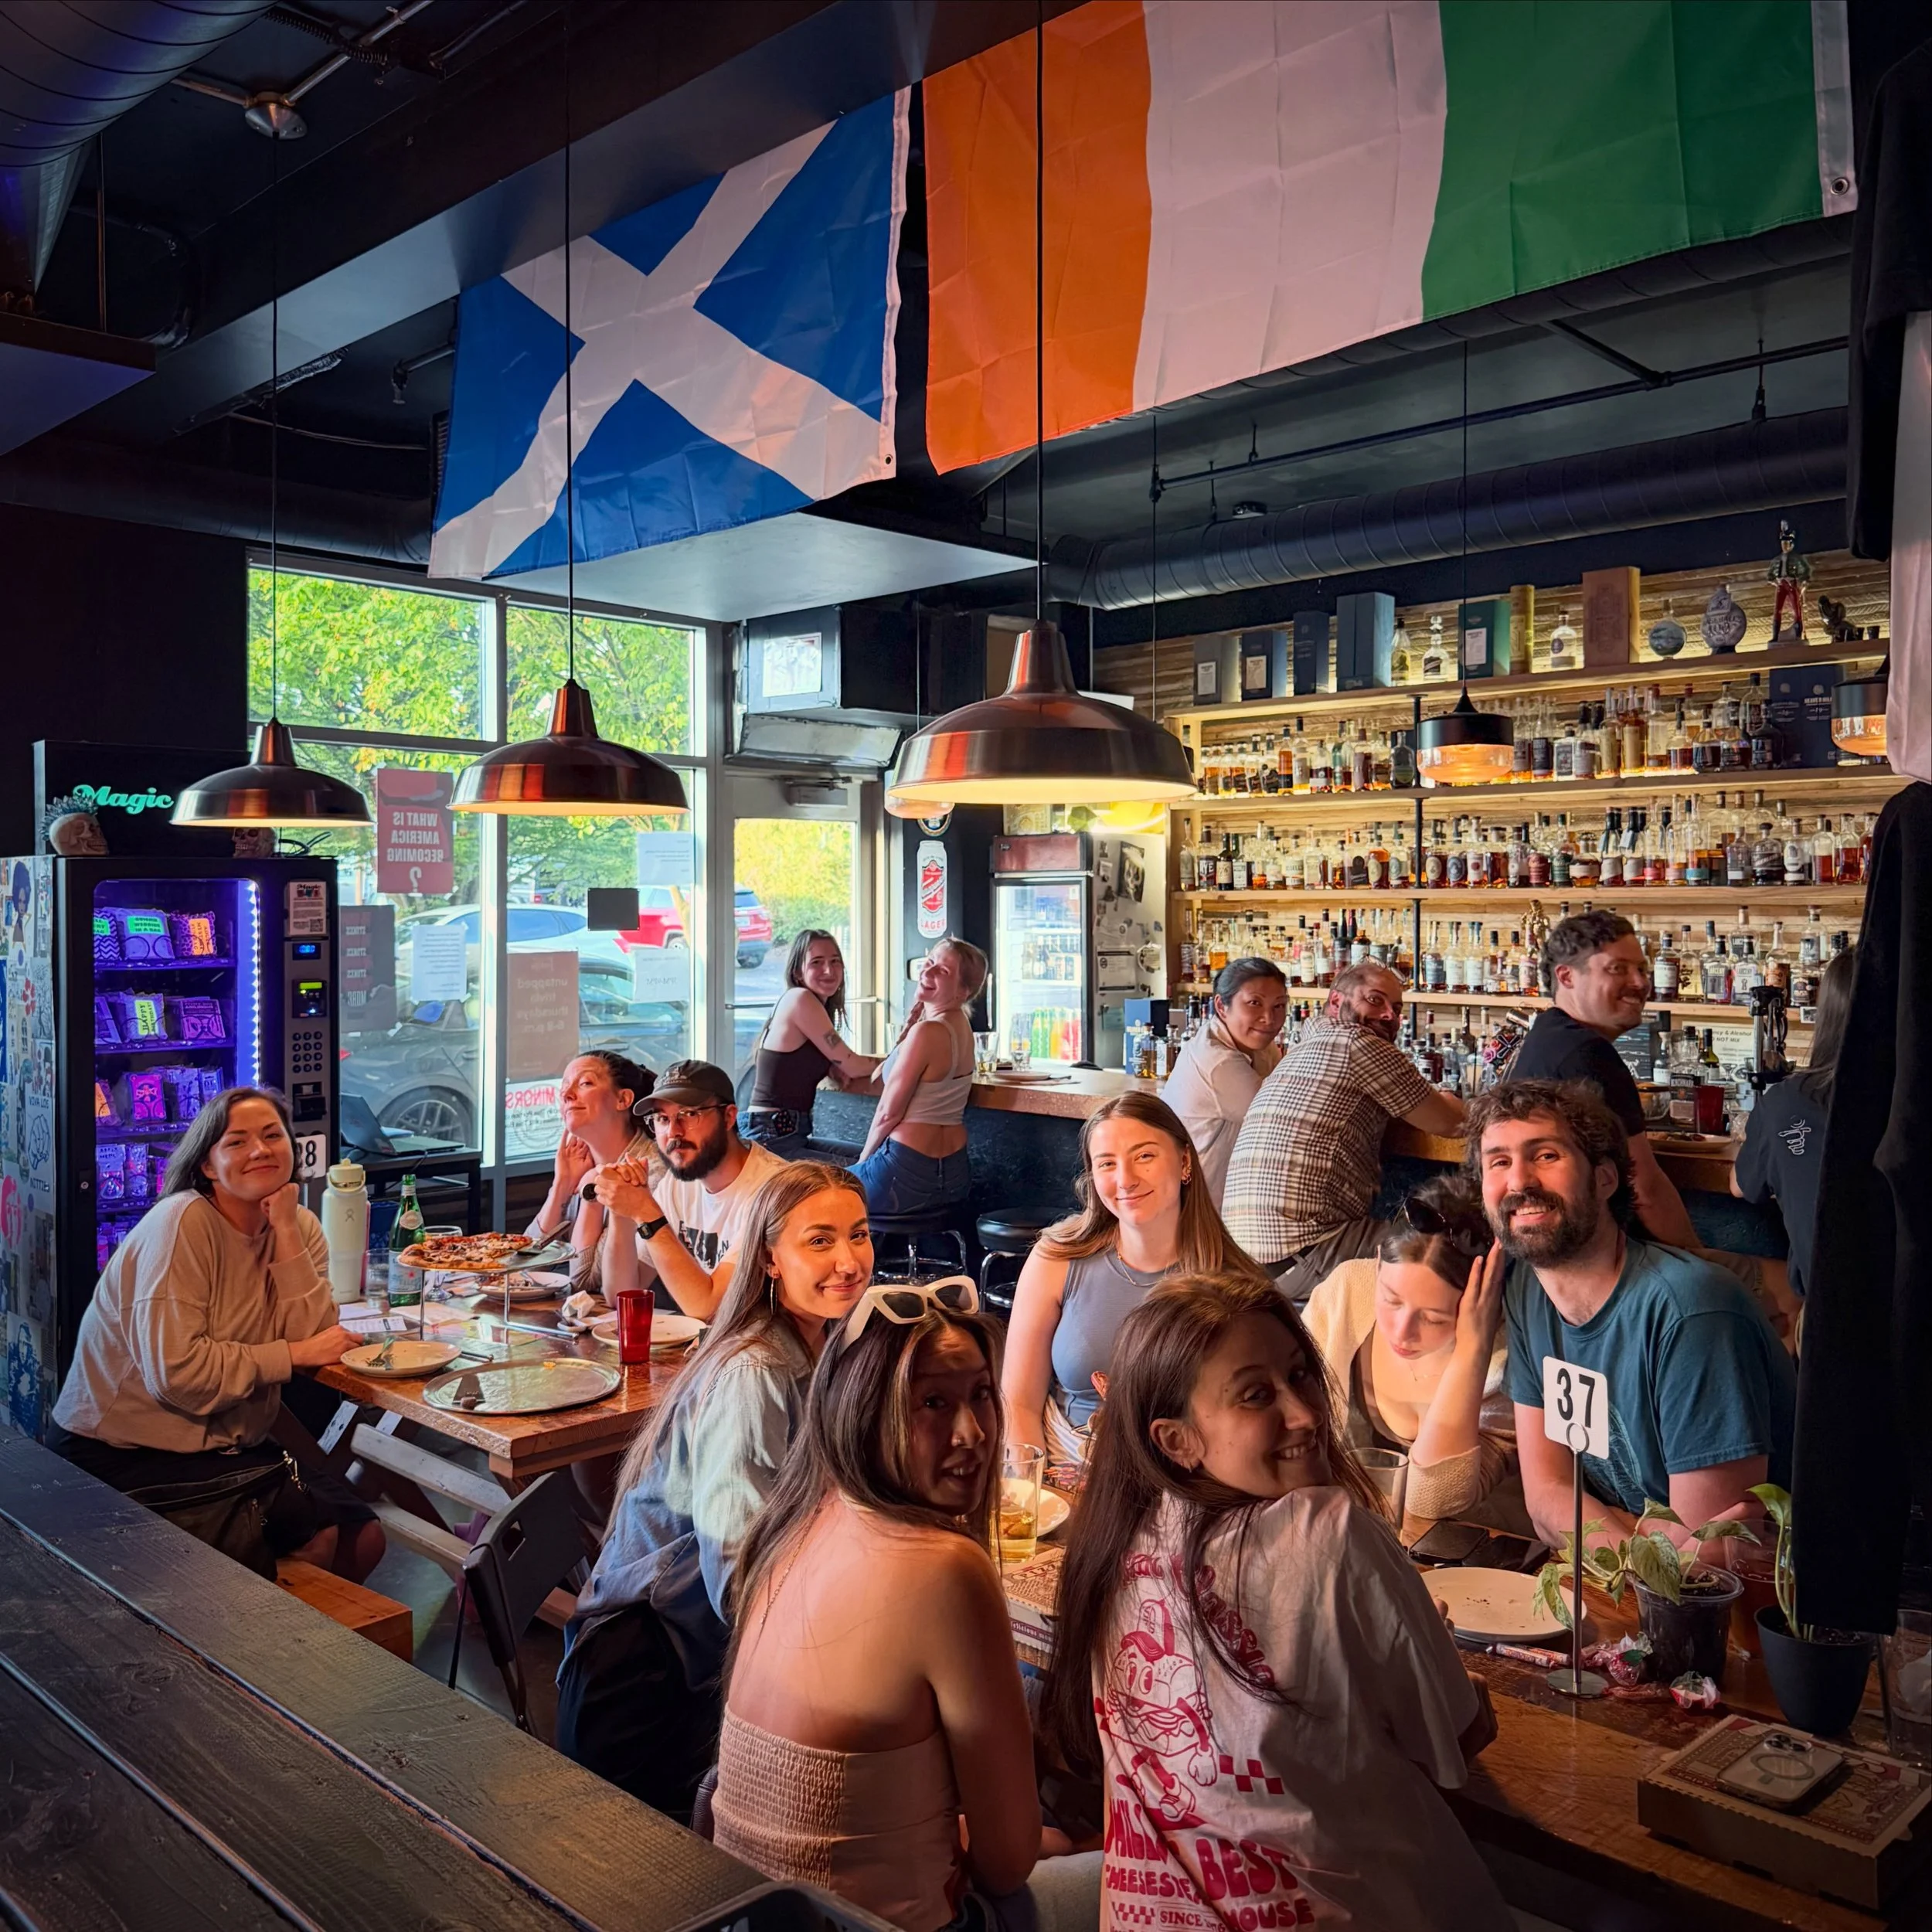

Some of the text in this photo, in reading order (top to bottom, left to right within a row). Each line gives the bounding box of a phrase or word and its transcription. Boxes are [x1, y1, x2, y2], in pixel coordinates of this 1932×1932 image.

[73, 784, 174, 814] Magic
[1199, 861, 1215, 874] RYE
[1556, 1367, 1596, 1429] 37
[1196, 1838, 1299, 1900] BEST
[1160, 1910, 1202, 1927] SINCE
[1223, 1899, 1315, 1932] HOUSE
